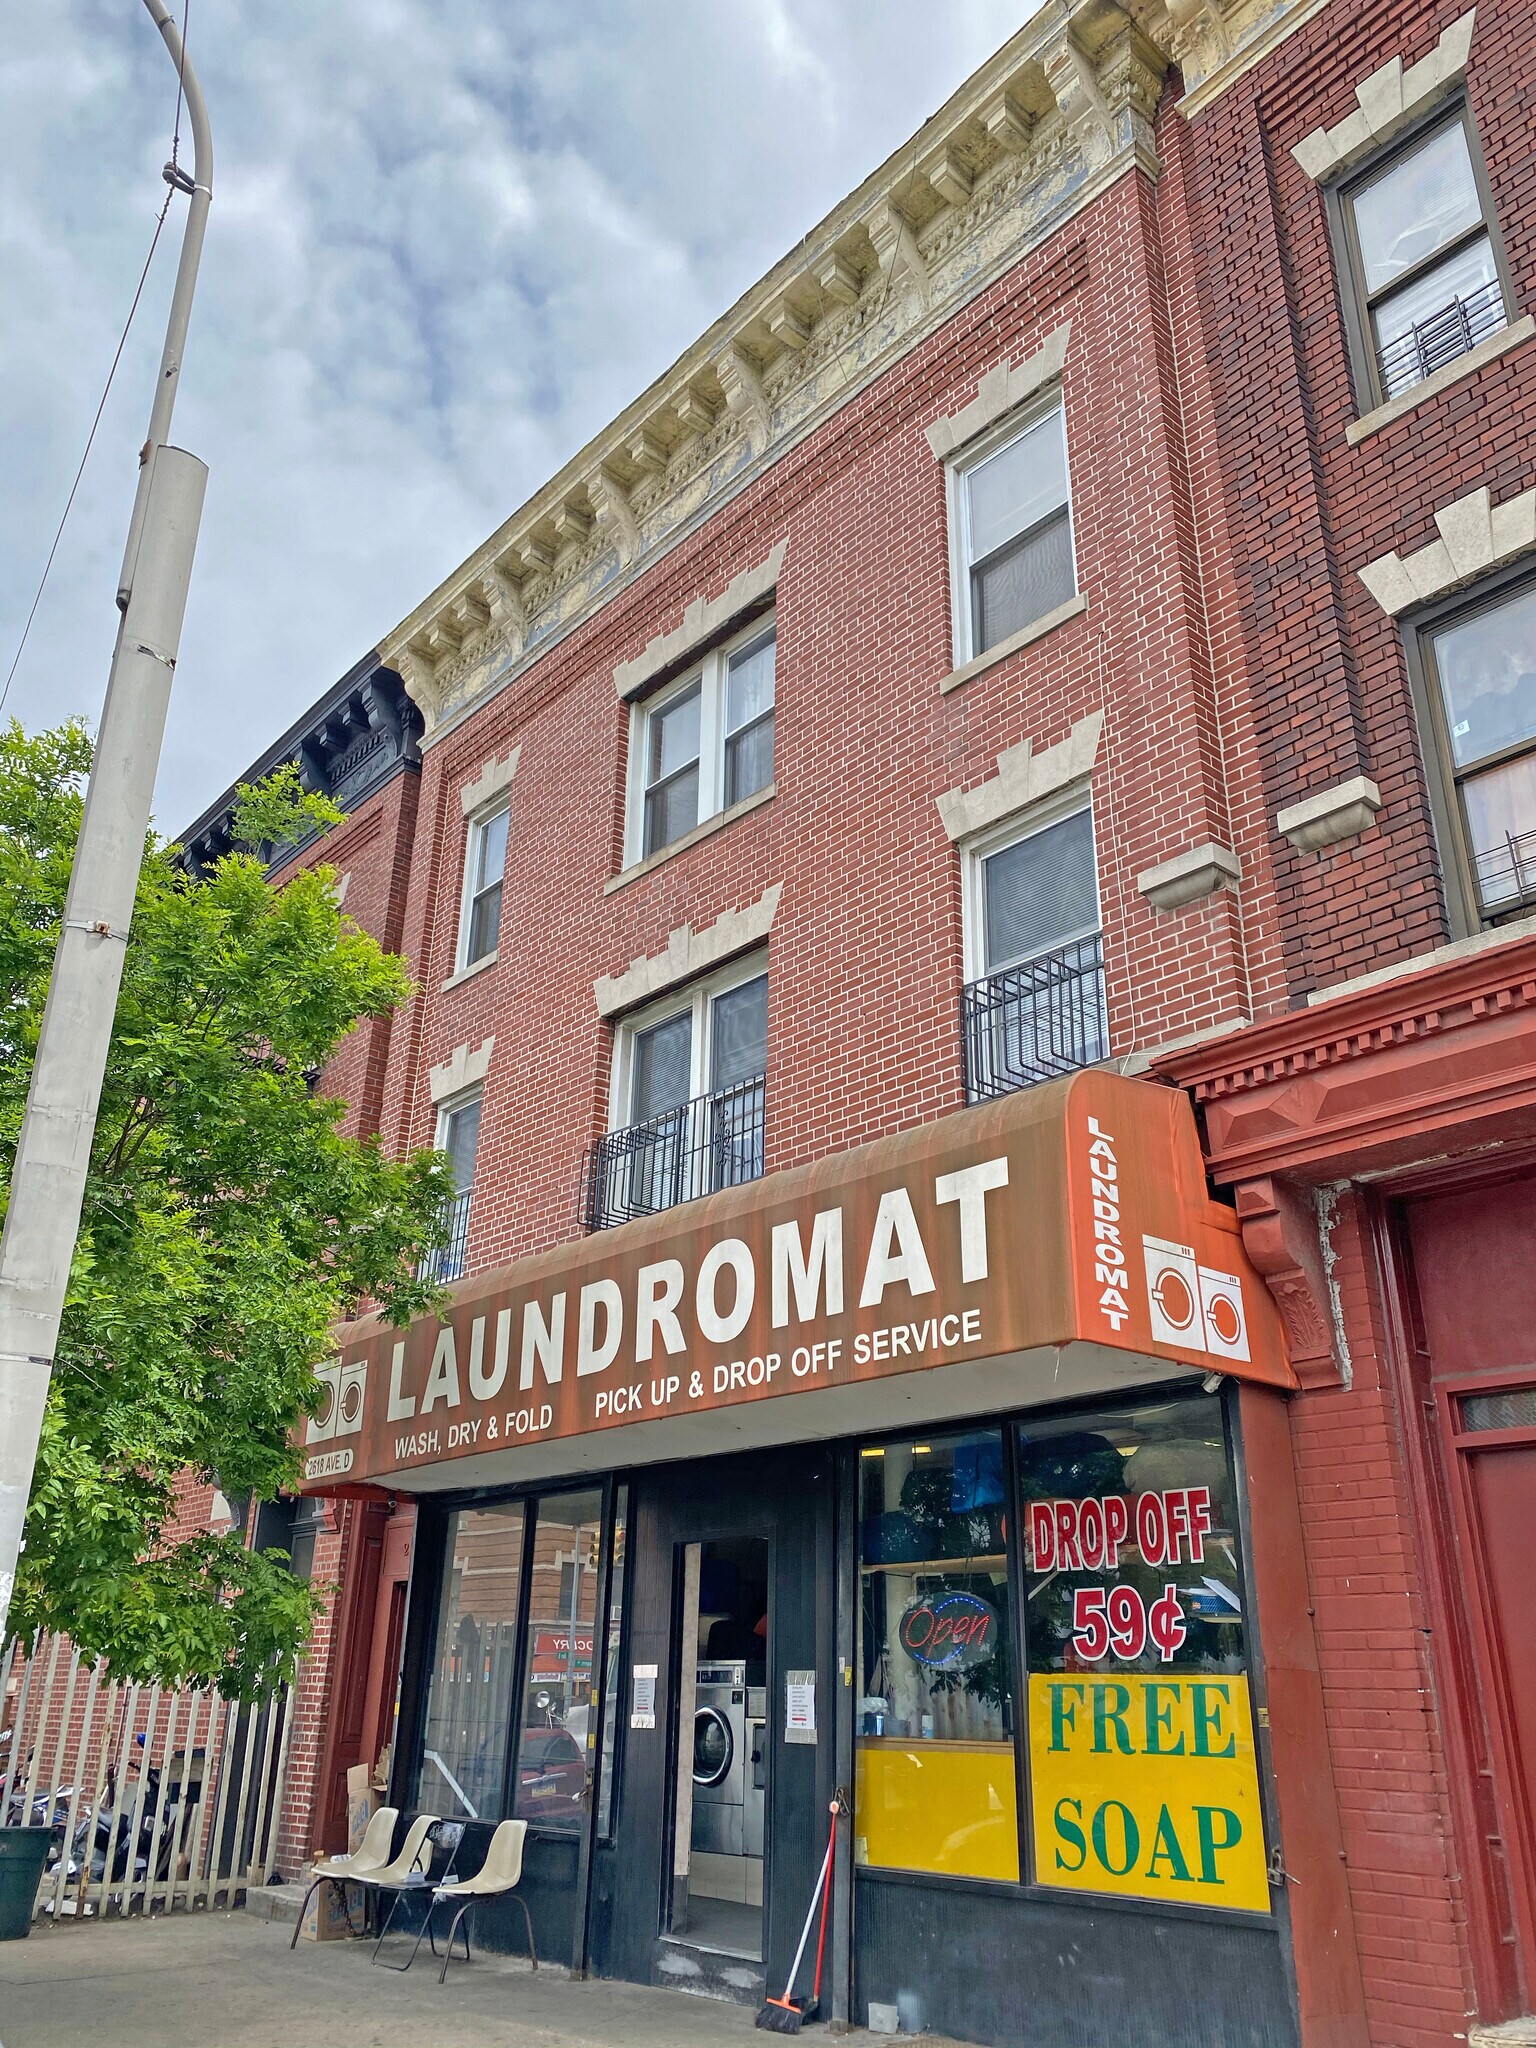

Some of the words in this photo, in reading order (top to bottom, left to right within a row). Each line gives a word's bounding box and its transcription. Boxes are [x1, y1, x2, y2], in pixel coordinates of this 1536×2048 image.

[1087, 1115, 1130, 1331] LAUNDROMAT
[386, 1156, 1009, 1423] LAUNDROMAT
[595, 1383, 643, 1418] PICK
[650, 1375, 680, 1406] UP
[688, 1370, 704, 1399] &
[713, 1353, 782, 1394] DROP
[791, 1338, 843, 1377] OFF
[853, 1308, 982, 1365] SERVICE
[308, 1458, 325, 1476] 2618
[325, 1454, 342, 1472] AVE.
[344, 1452, 350, 1469] D
[394, 1429, 442, 1460] WASH,
[447, 1418, 482, 1448] DRY
[486, 1415, 499, 1440] &
[505, 1404, 553, 1437] FOLD
[1030, 1495, 1128, 1574] DROP
[1136, 1485, 1212, 1568] OFF
[905, 1606, 990, 1658] Open
[1072, 1583, 1187, 1662] 59¢
[1046, 1682, 1236, 1759] FREE
[1053, 1797, 1243, 1885] SOAP
